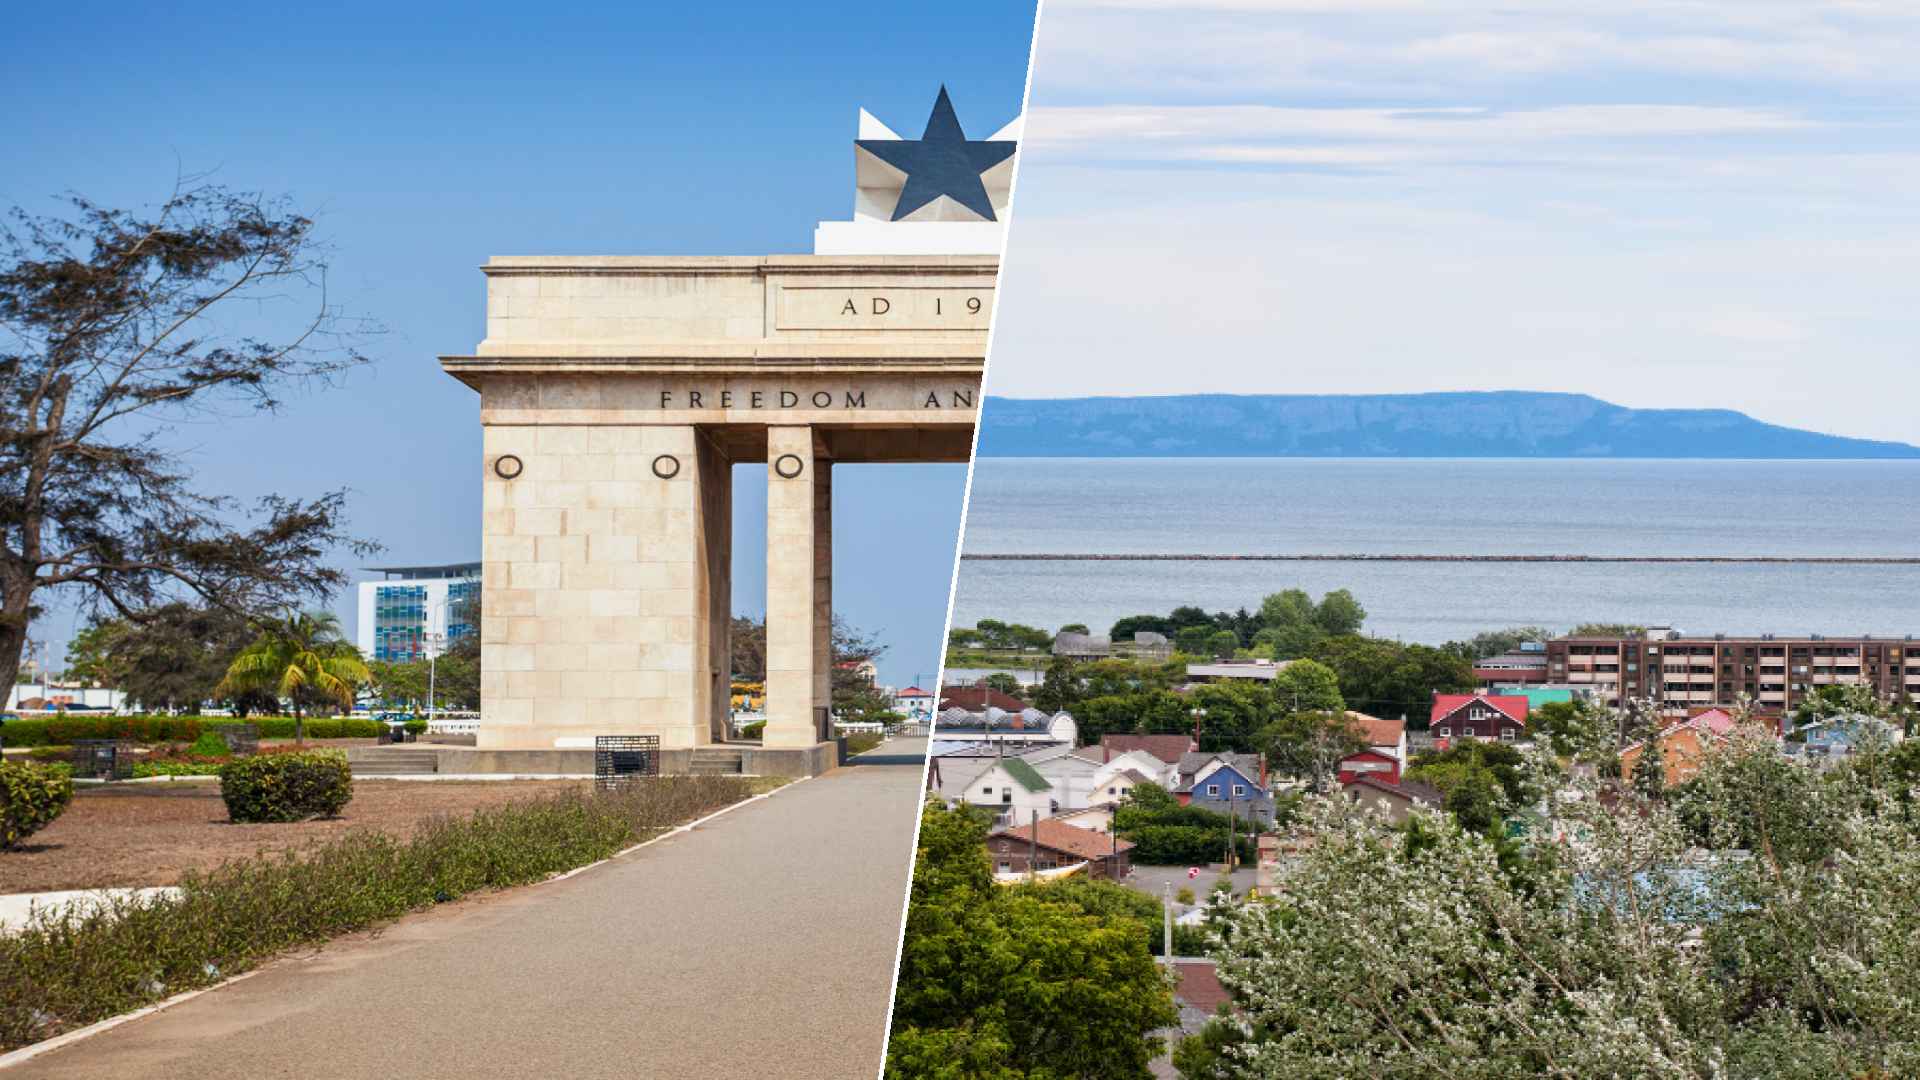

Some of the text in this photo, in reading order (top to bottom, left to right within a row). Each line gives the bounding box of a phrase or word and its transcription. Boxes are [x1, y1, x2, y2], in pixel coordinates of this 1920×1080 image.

[841, 297, 890, 315] AD
[660, 391, 972, 408] FREEDOM AN
